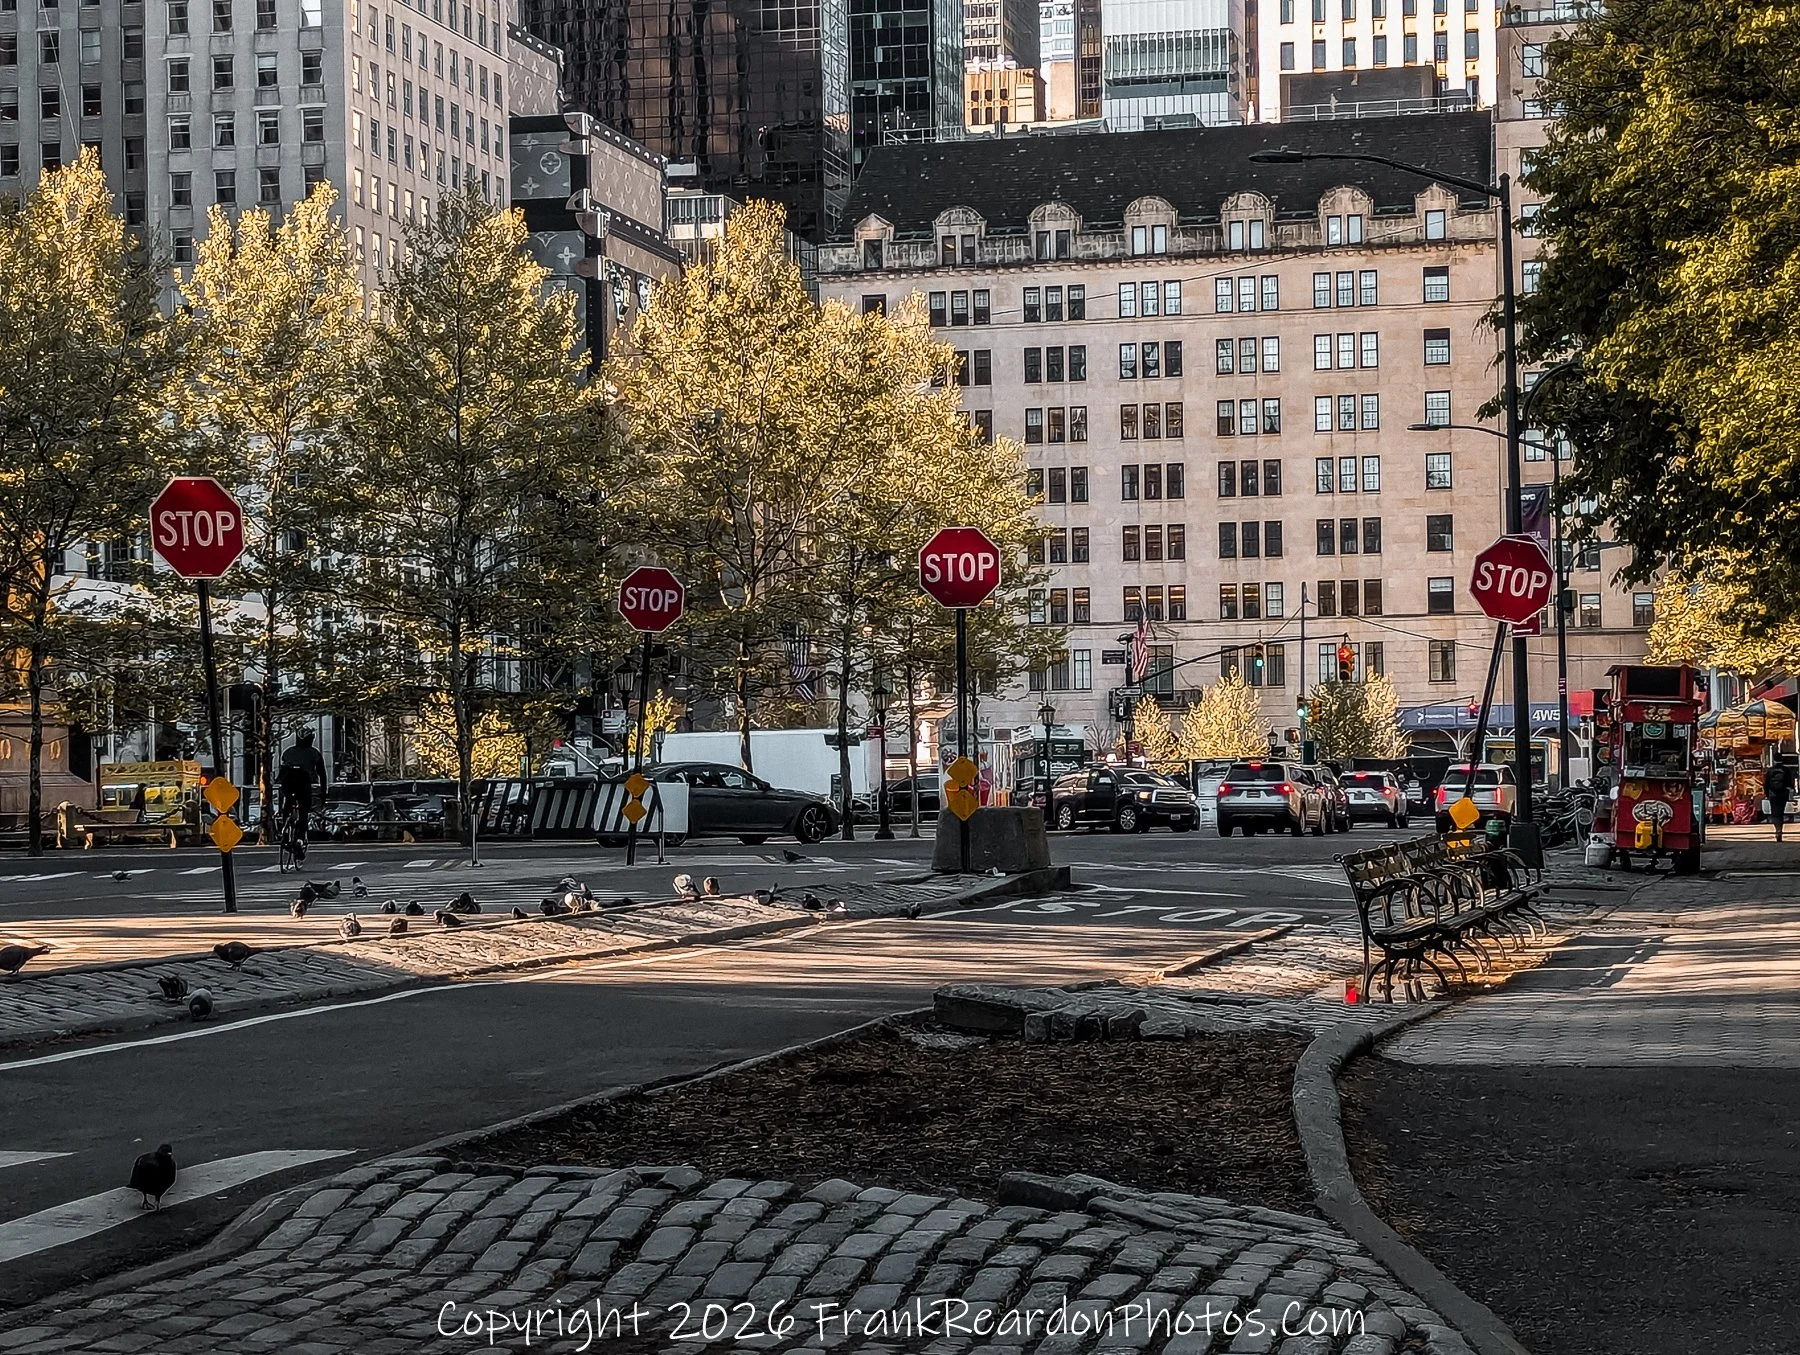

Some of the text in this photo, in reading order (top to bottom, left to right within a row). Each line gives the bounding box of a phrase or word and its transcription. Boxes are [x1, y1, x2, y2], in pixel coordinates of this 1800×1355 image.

[159, 510, 236, 547] STOP
[924, 552, 995, 583] STOP
[1475, 561, 1548, 600] STOP
[624, 587, 678, 612] STOP
[1012, 901, 1304, 927] STOP
